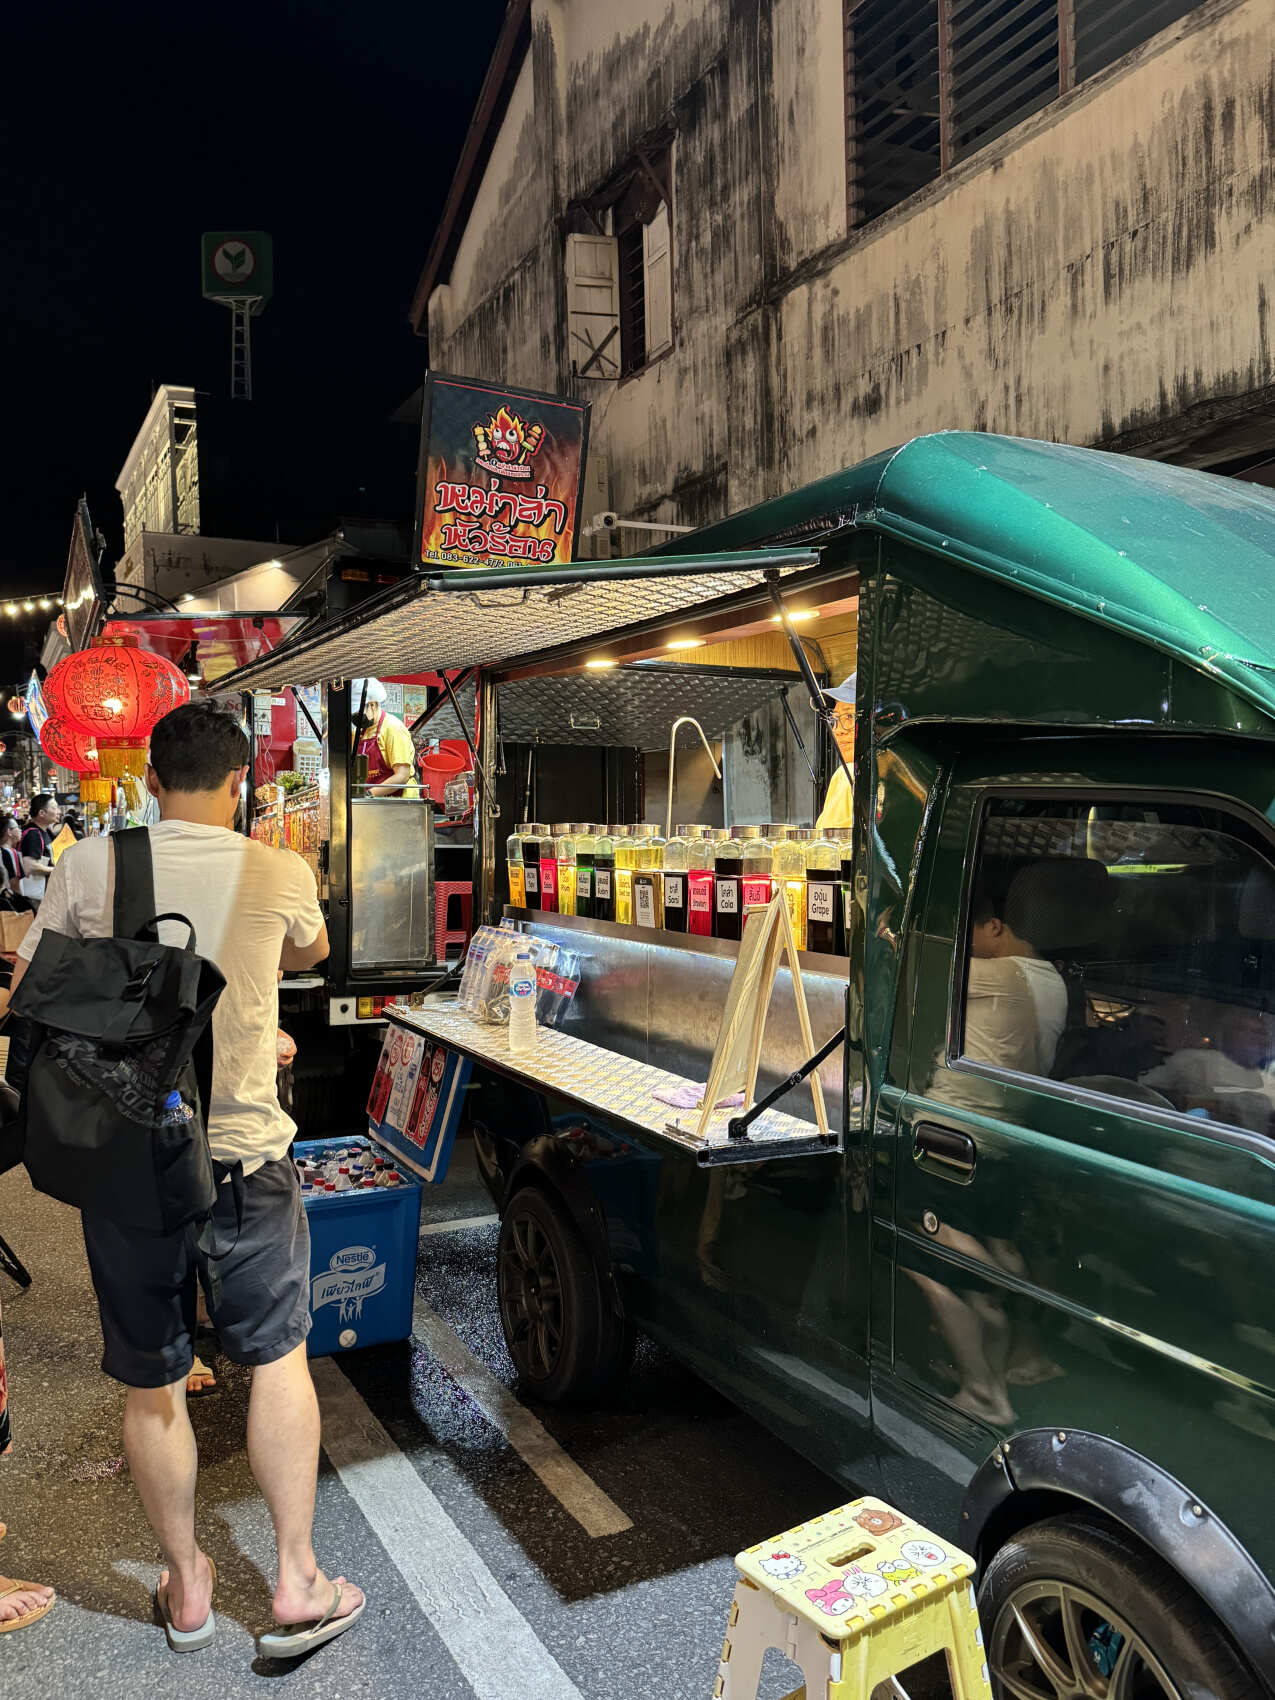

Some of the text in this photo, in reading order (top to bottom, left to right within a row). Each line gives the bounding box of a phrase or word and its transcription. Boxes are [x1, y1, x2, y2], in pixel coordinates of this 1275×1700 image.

[436, 479, 566, 532] หม่าล่า
[441, 519, 554, 561] หัวร้อน
[720, 899, 734, 909] Cola
[811, 903, 830, 917] Grape
[336, 1251, 370, 1265] Nestlé
